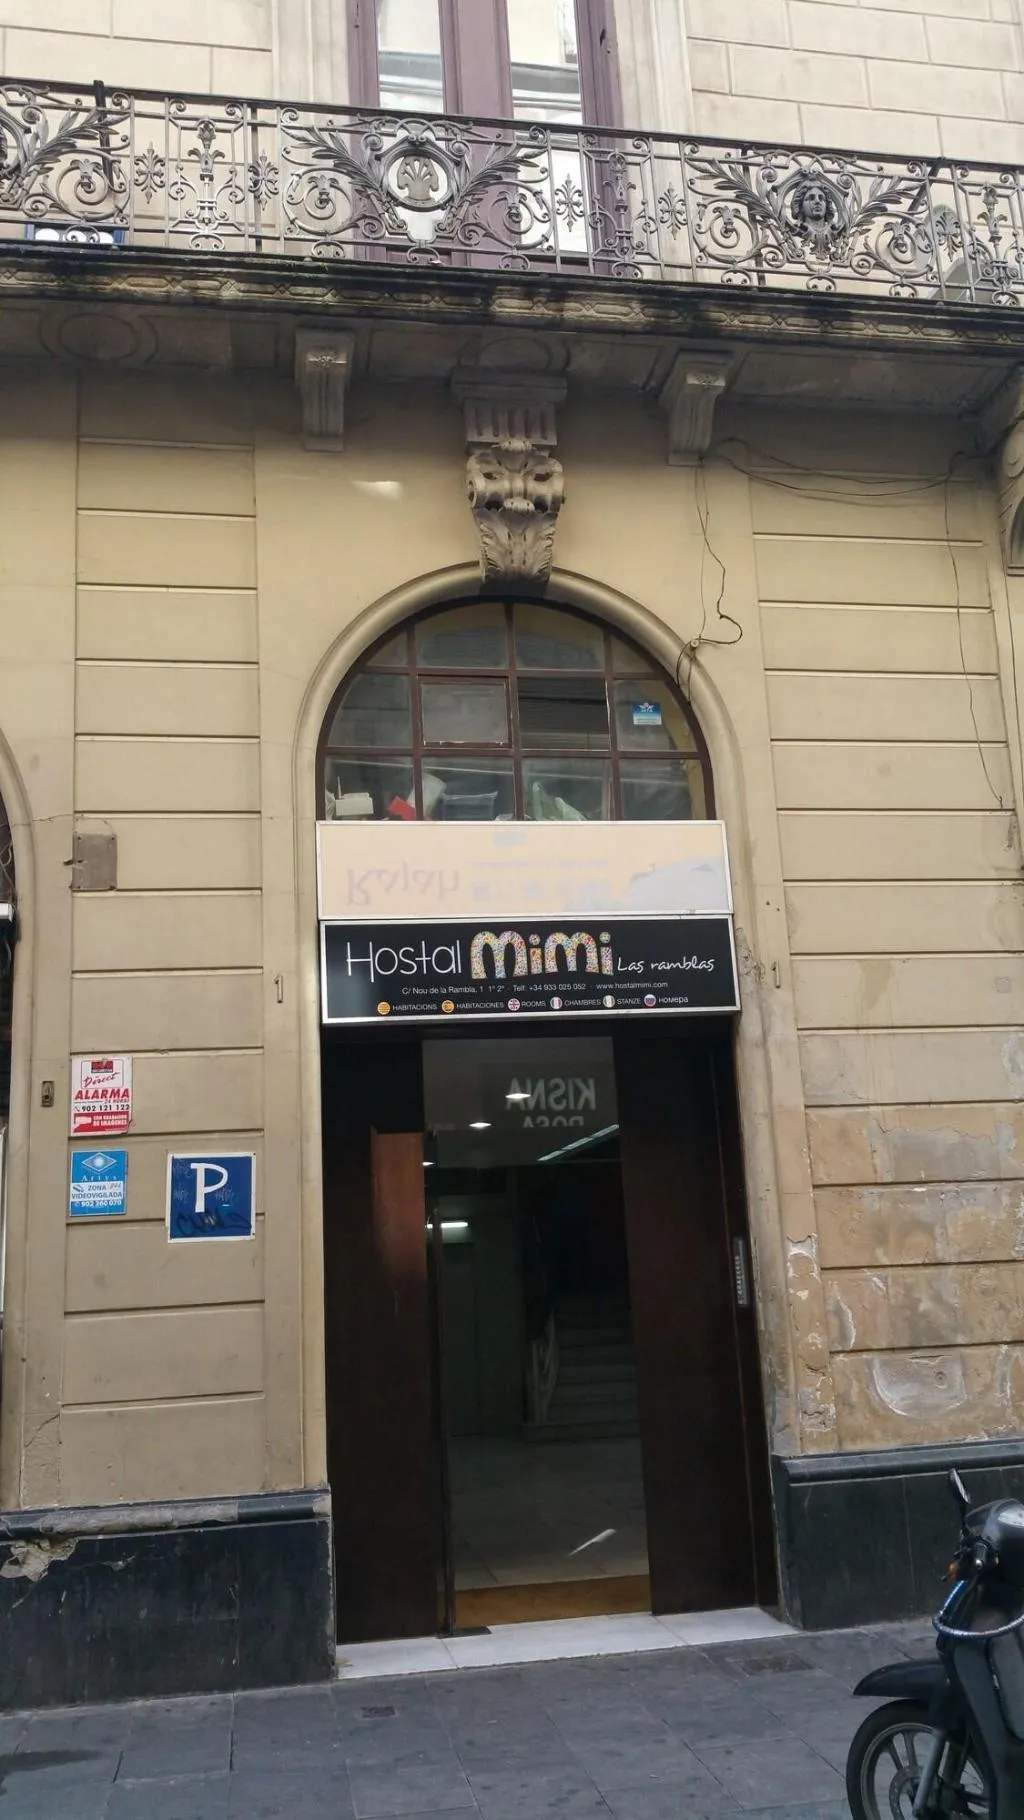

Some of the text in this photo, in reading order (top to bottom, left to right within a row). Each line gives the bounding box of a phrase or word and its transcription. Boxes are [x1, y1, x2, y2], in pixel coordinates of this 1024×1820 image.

[346, 930, 716, 983] Hostal mimi Las ramblas
[412, 986, 428, 995] Nou
[429, 986, 439, 994] de
[440, 986, 447, 994] la
[448, 985, 478, 994] Rambla,
[595, 981, 669, 990] www.hostalmimi.com
[392, 1003, 438, 1011] HABITACIONS
[456, 1001, 505, 1009] HABITACIONES
[83, 1072, 121, 1088] Direct
[74, 1088, 130, 1100] ALARMA
[190, 1162, 229, 1213] P
[72, 1191, 122, 1199] VIDEOVIGILADA
